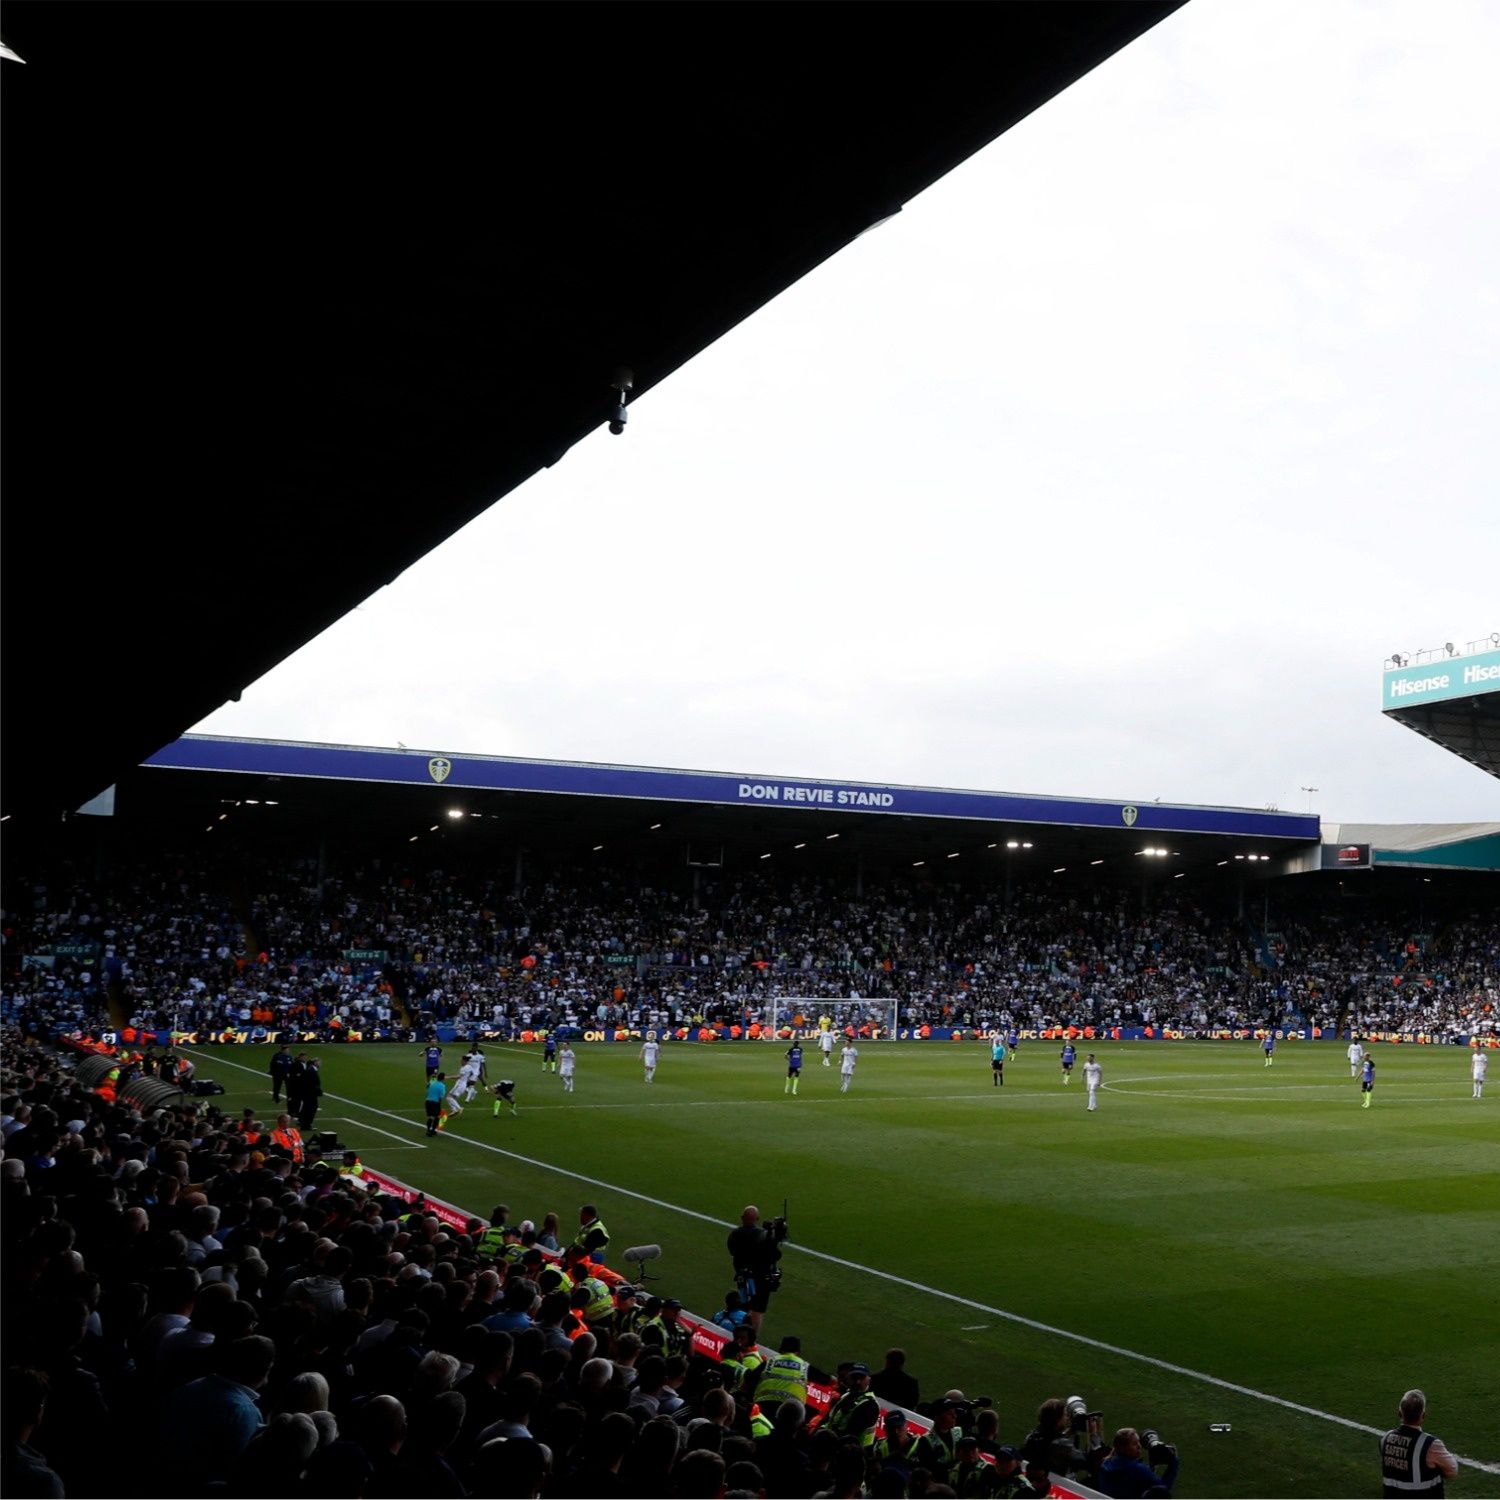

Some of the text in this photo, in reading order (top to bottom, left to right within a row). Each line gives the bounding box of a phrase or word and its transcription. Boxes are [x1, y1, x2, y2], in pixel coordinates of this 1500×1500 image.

[1390, 675, 1450, 697] Hisense
[739, 784, 894, 807] DON REVIE STAND
[583, 1030, 605, 1042] ON
[1386, 1433, 1412, 1447] DEPUTY
[1385, 1444, 1408, 1459] SAFETY
[1384, 1455, 1409, 1471] OFFICER
